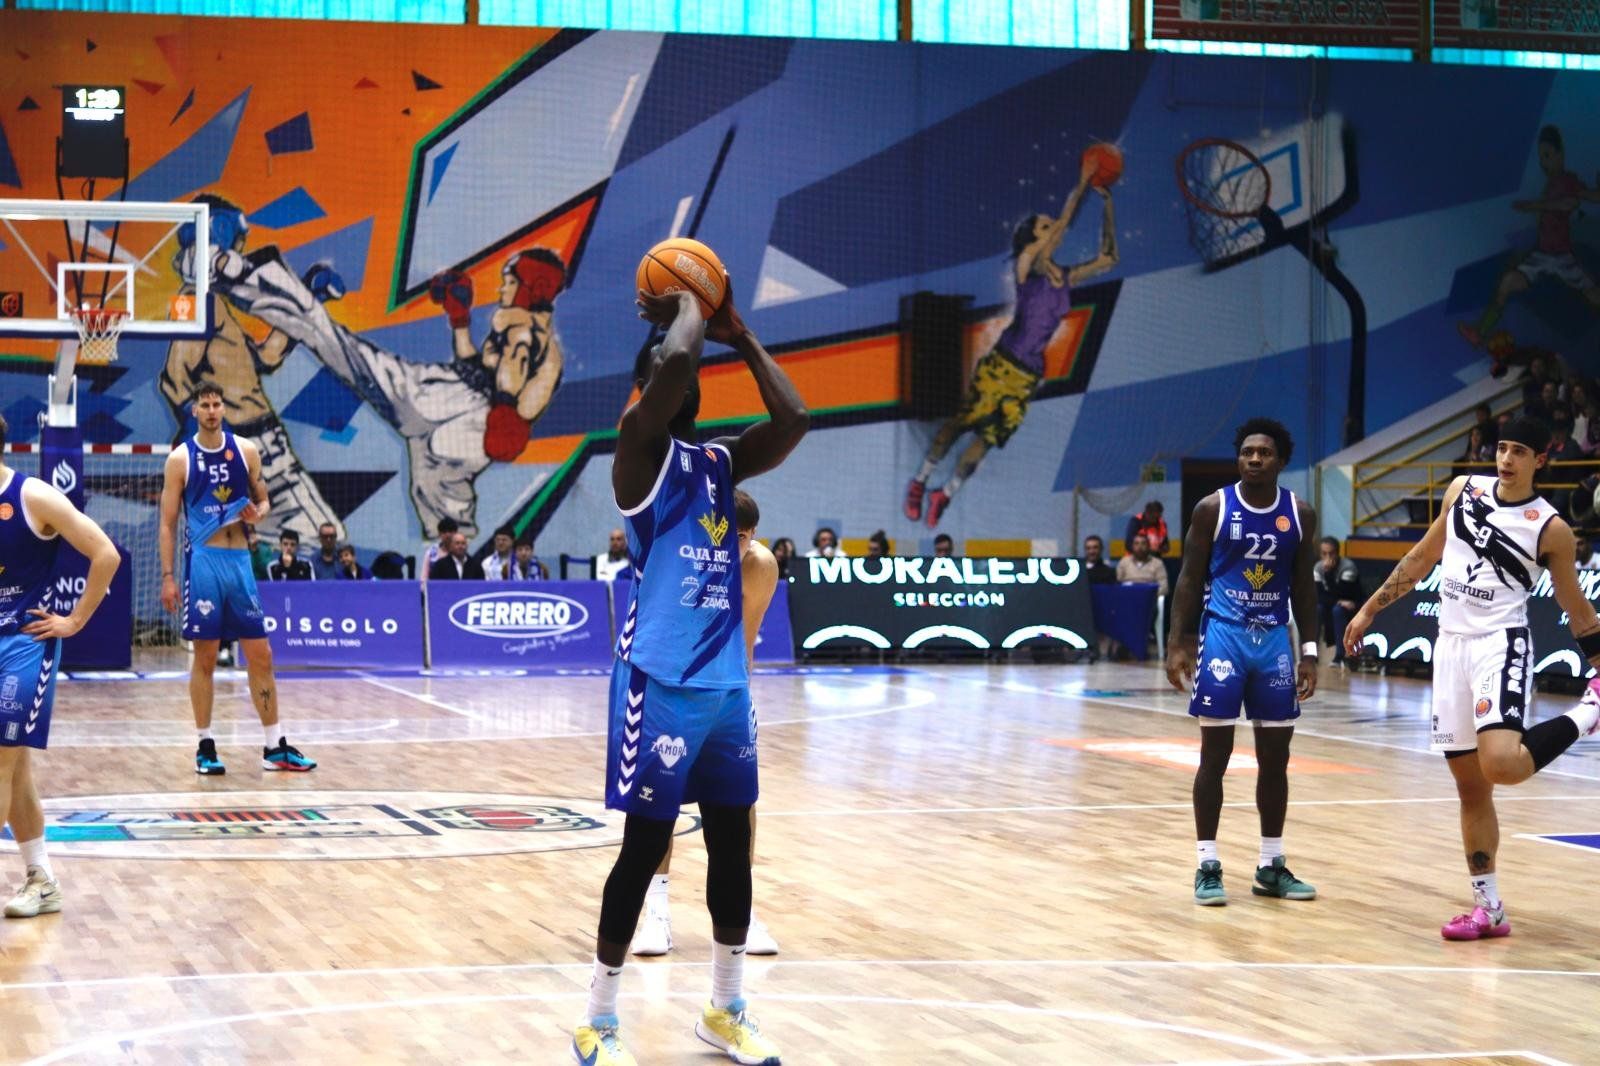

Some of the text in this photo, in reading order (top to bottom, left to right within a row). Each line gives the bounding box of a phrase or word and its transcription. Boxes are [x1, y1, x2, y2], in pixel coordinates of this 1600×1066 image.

[209, 464, 229, 483] 55
[1475, 525, 1493, 548] 9
[680, 545, 711, 561] CAJA
[1244, 533, 1277, 560] 22
[694, 562, 704, 571] DE
[809, 556, 1081, 585] MORALEJO
[893, 591, 1005, 607] SELECCIÓN
[467, 602, 571, 626] FERRERO
[287, 638, 362, 648] UVA TINTA DE TORO
[1207, 662, 1236, 676] ZAMORA
